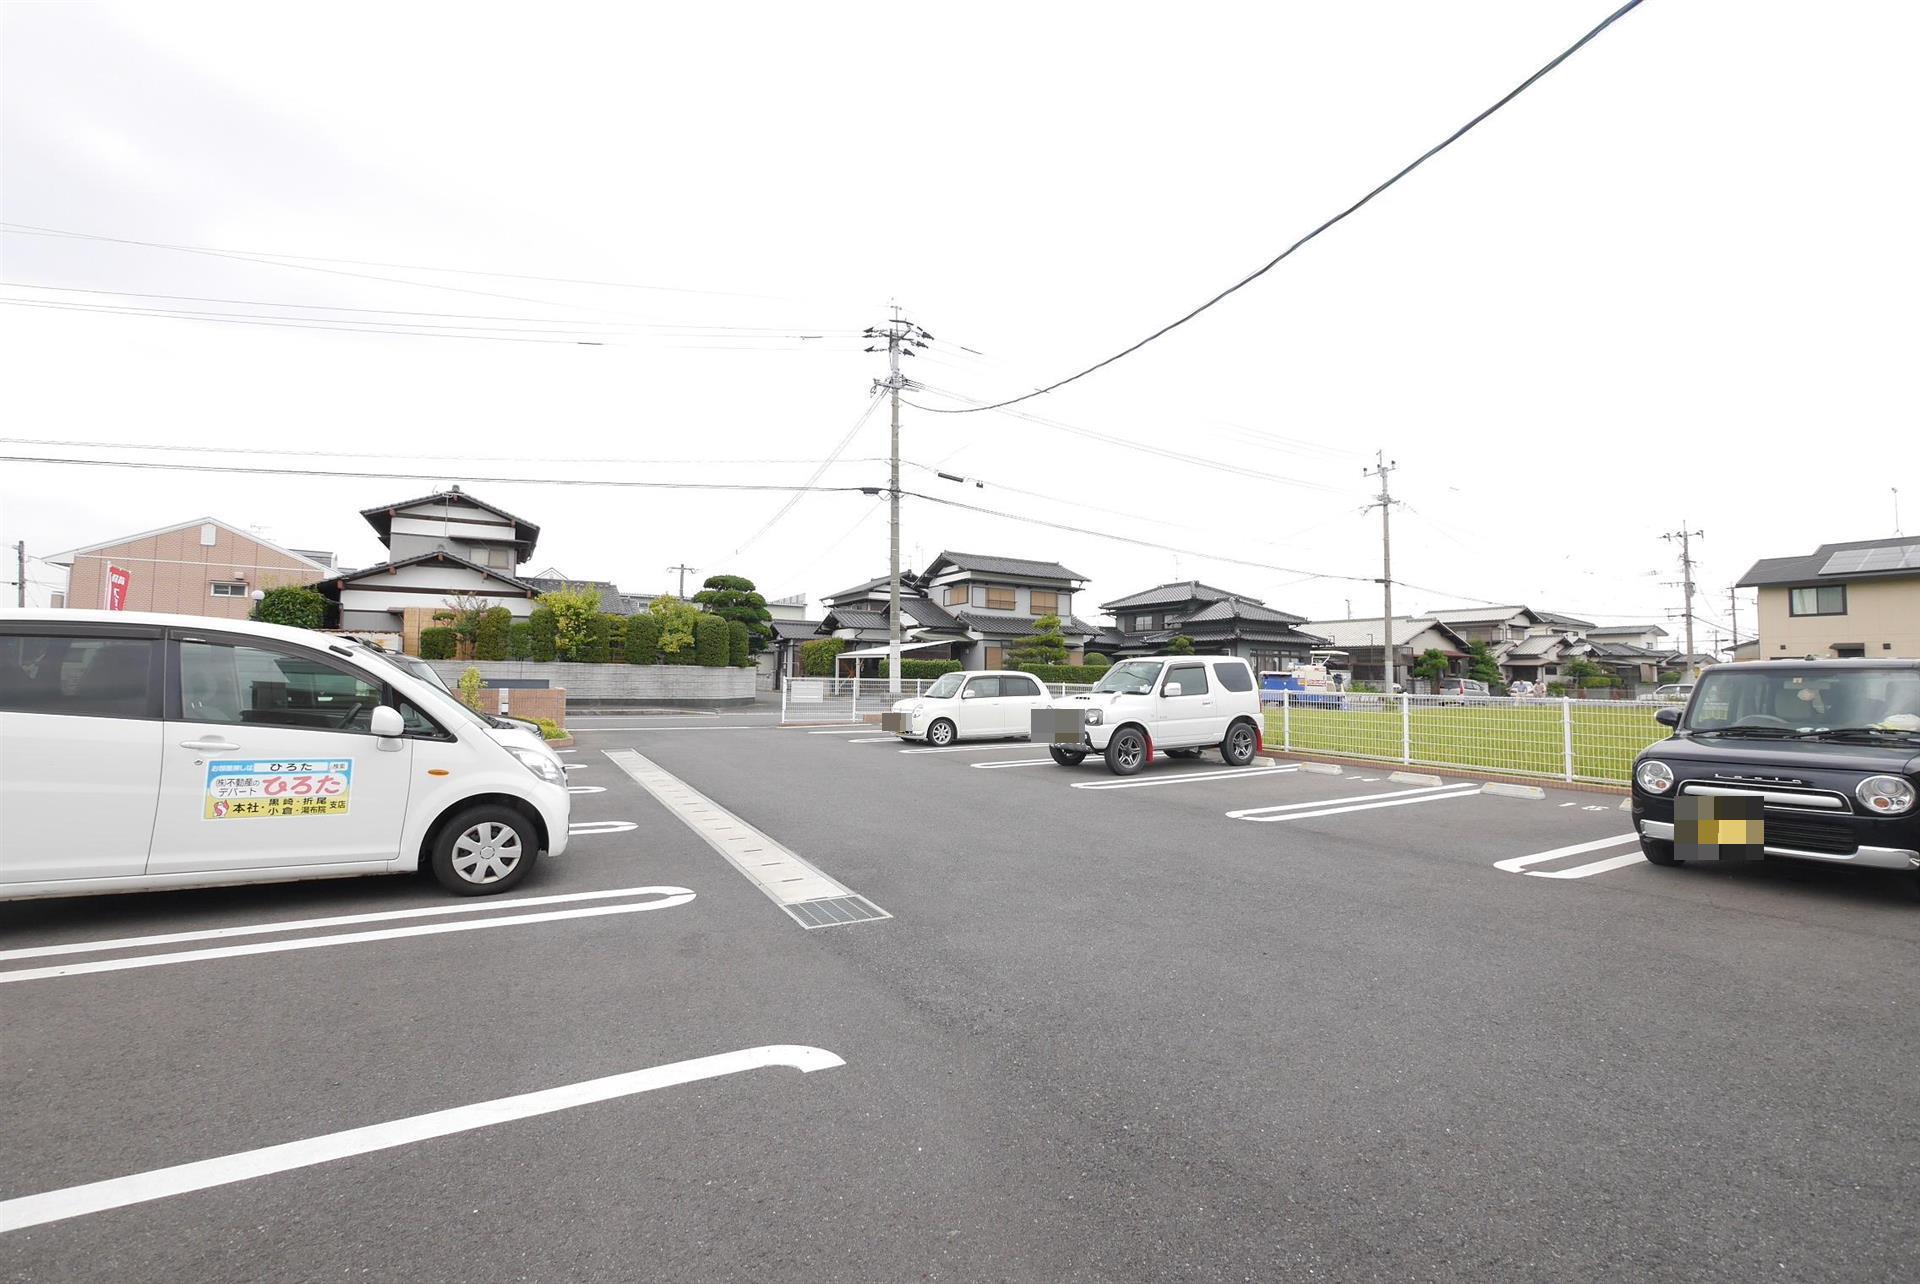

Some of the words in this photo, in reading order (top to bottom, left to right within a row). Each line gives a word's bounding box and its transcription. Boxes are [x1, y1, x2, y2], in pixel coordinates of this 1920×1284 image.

[270, 763, 313, 772] ひろた
[262, 775, 342, 796] ひろた
